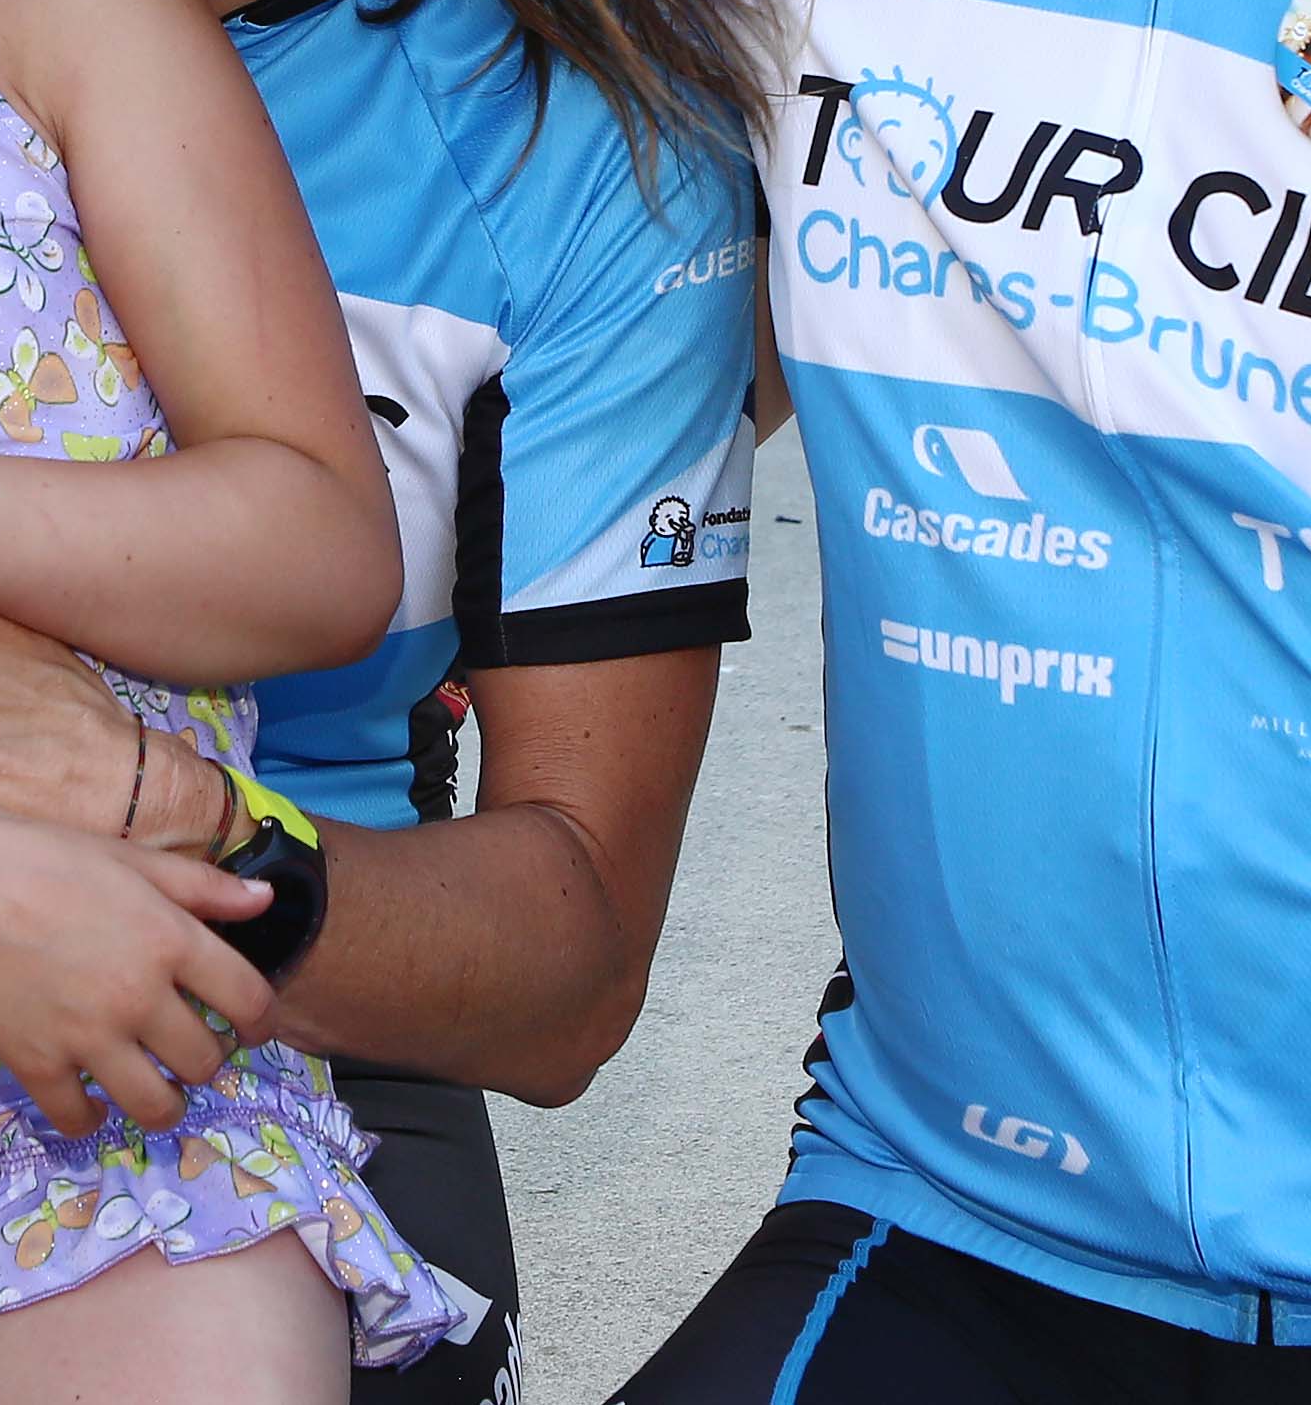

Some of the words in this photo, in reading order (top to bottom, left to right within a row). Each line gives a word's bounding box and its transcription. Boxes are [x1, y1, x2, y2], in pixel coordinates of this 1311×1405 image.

[798, 66, 1143, 235] TOUR
[654, 236, 755, 295] QUÉB
[864, 487, 1112, 571] Cascades
[919, 627, 1114, 705] uniprix
